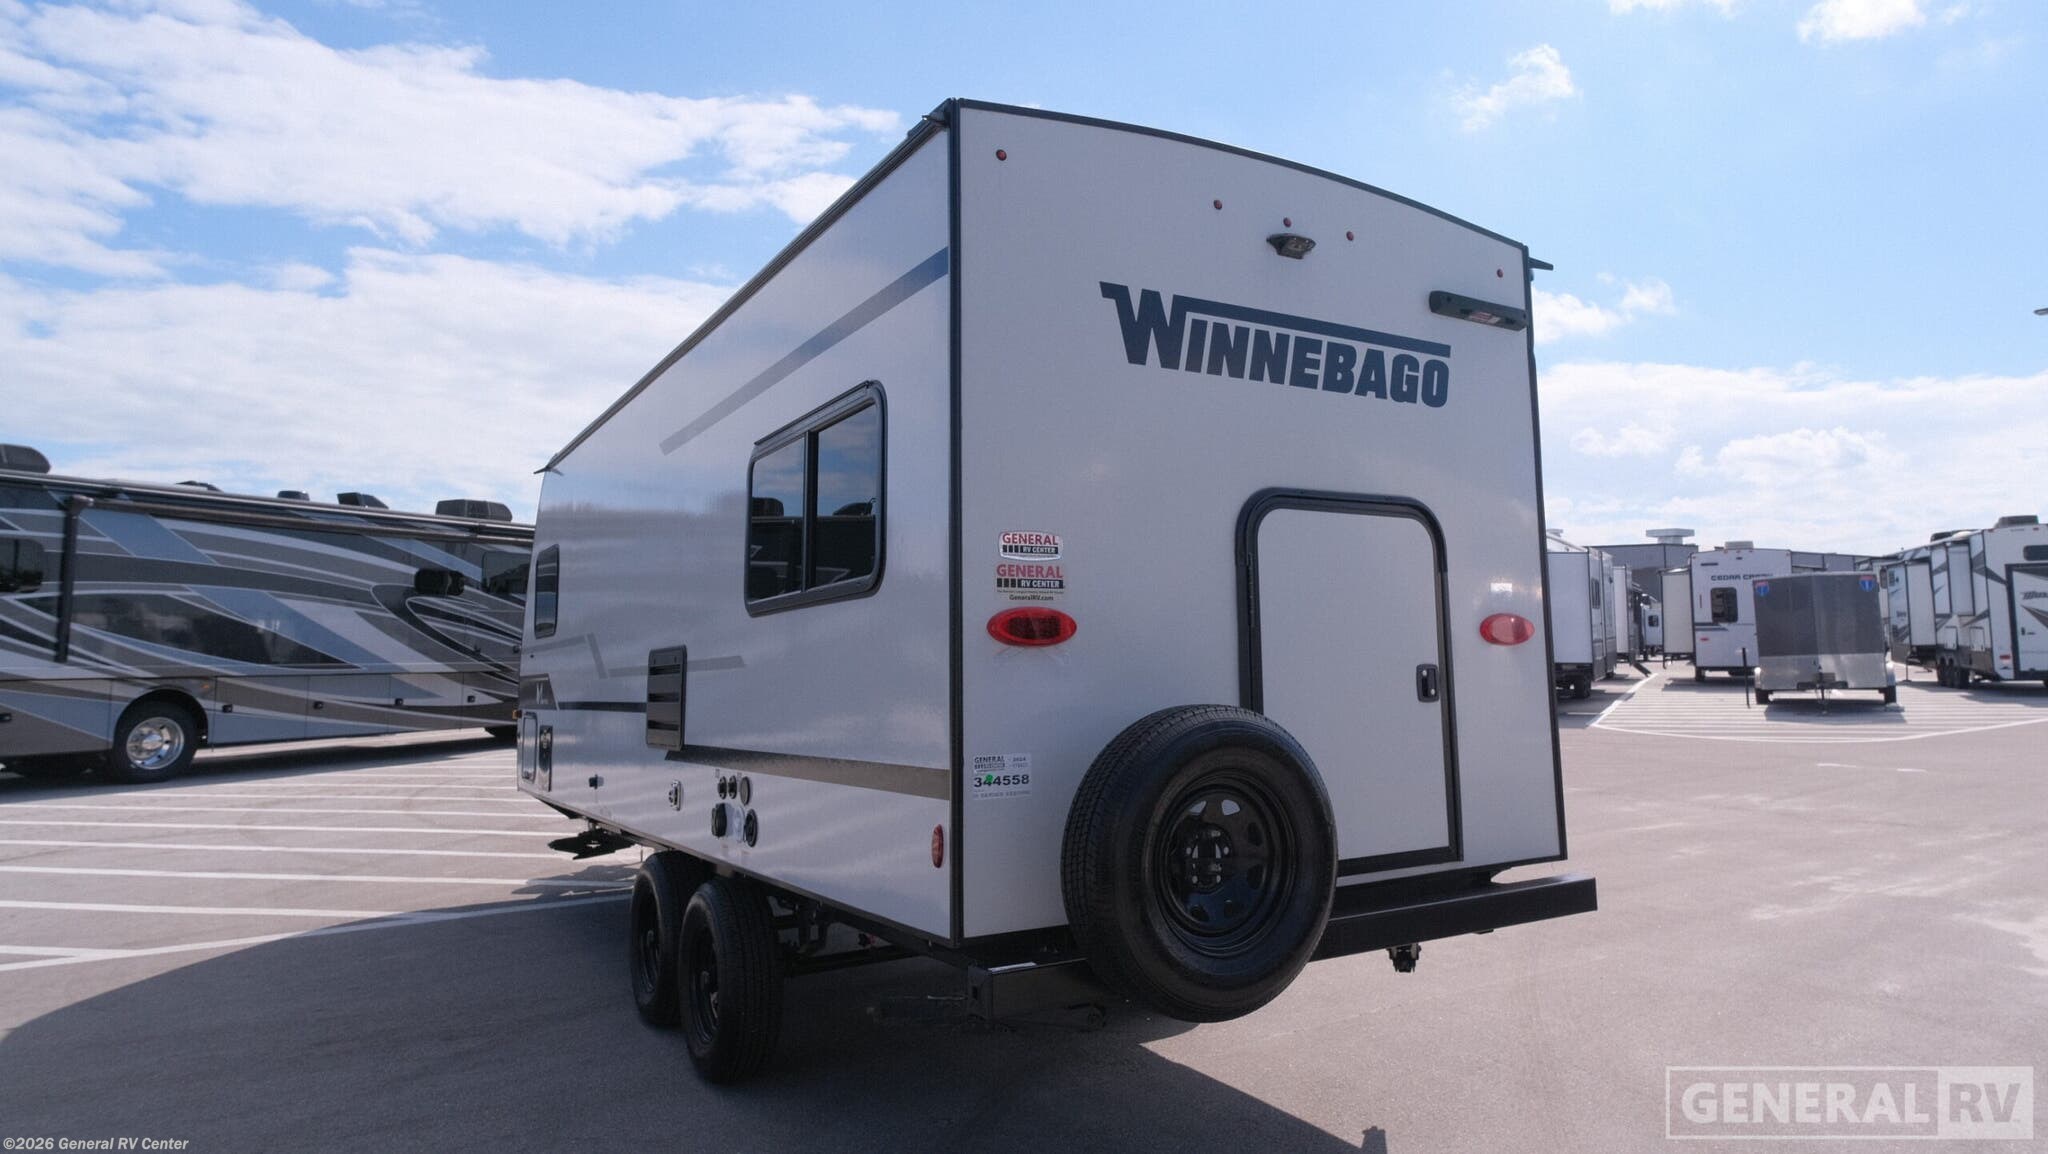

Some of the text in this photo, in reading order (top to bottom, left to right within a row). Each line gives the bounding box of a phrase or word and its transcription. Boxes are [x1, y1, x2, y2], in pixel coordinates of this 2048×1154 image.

[1099, 281, 1452, 408] WINNEBAGO
[1002, 533, 1058, 545] GENERAL
[997, 564, 1063, 578] GENERAL
[1021, 580, 1060, 588] RV CENTER
